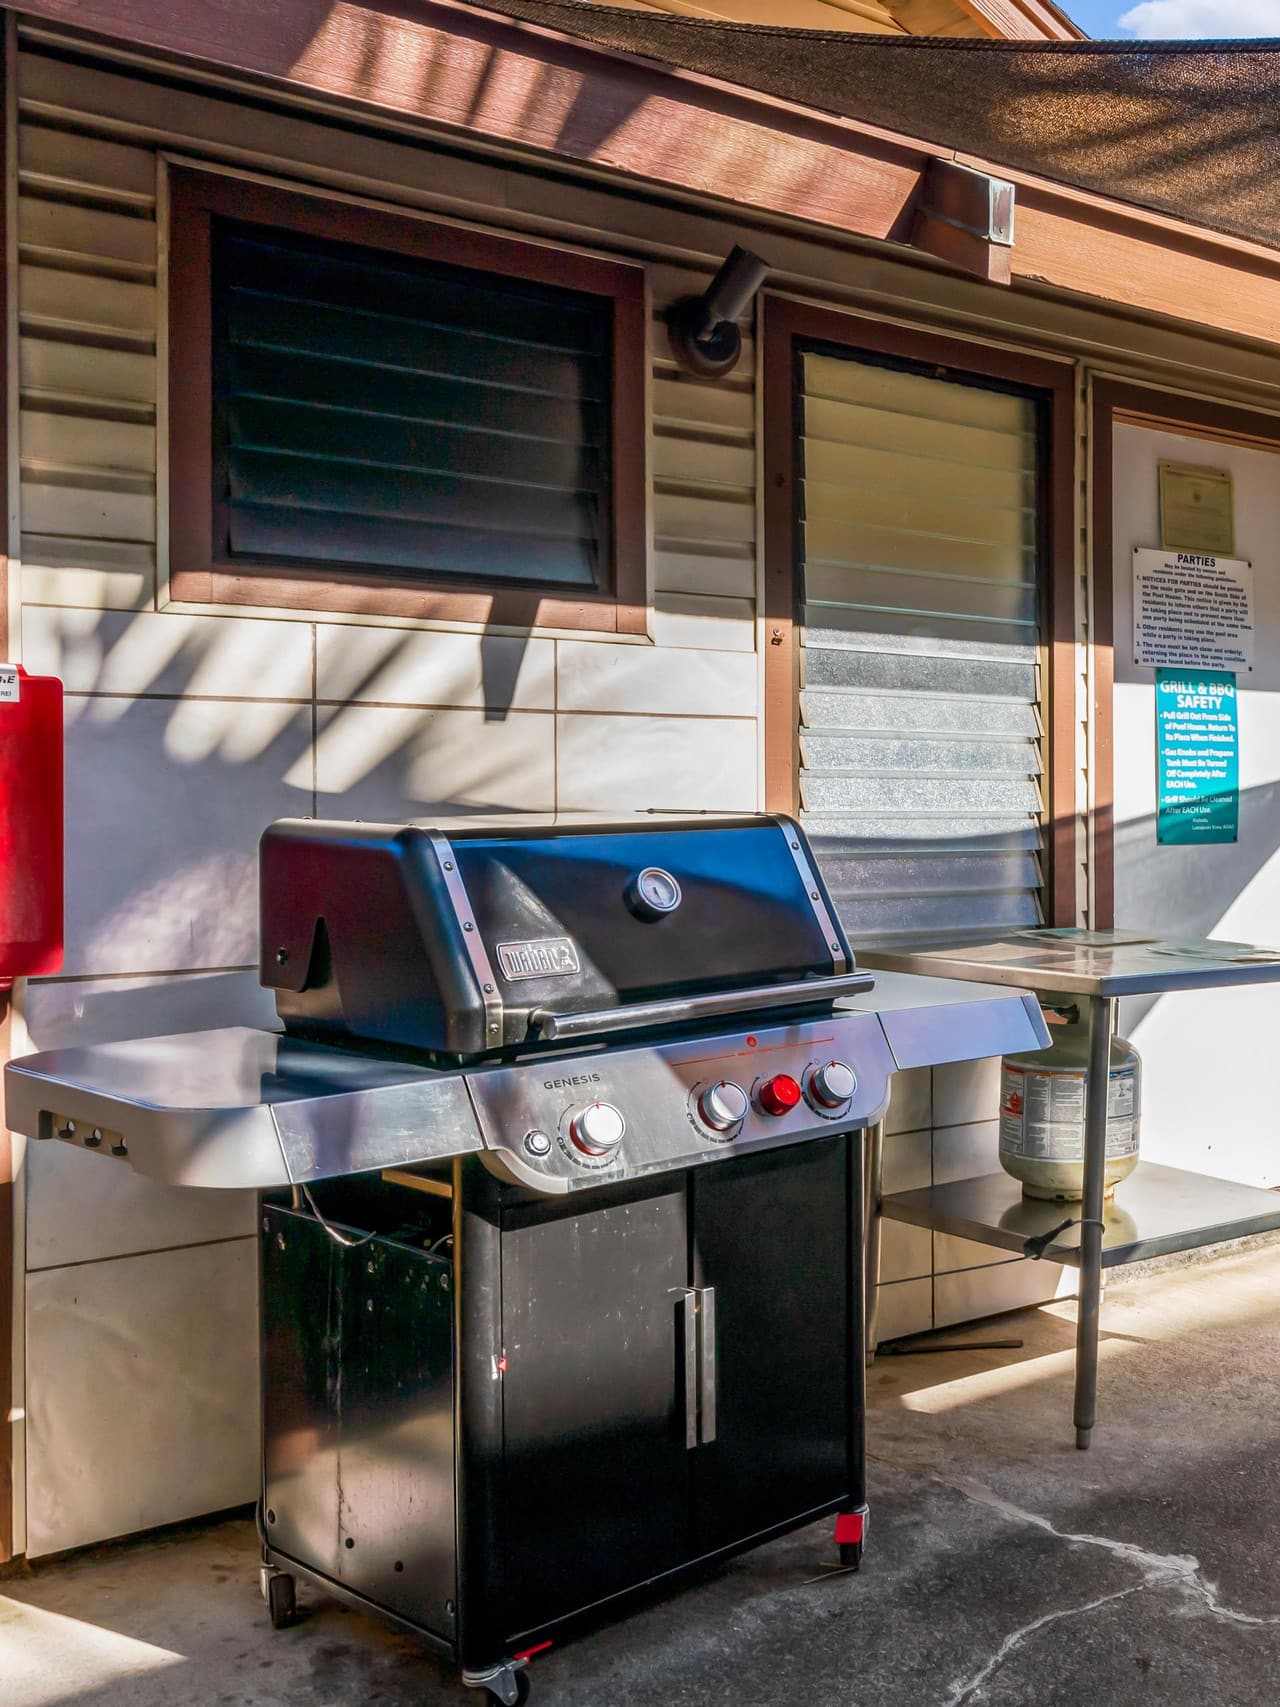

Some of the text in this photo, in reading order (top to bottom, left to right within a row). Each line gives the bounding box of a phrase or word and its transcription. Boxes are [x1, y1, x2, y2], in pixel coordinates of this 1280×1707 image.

[1178, 554, 1215, 567] PARTIES
[1150, 607, 1166, 615] taking
[1169, 616, 1182, 624] being
[1160, 680, 1234, 698] GRILL & BBQ
[1177, 695, 1222, 709] SAFETY
[1163, 711, 1175, 719] Pull
[1176, 712, 1189, 720] Grill
[1190, 712, 1201, 720] Out
[1172, 722, 1186, 730] Pool
[1165, 748, 1176, 756] Gas
[1177, 770, 1210, 779] Completely
[1166, 780, 1183, 789] EACH
[1182, 806, 1198, 814] EACH
[544, 1073, 600, 1090] GENESIS
